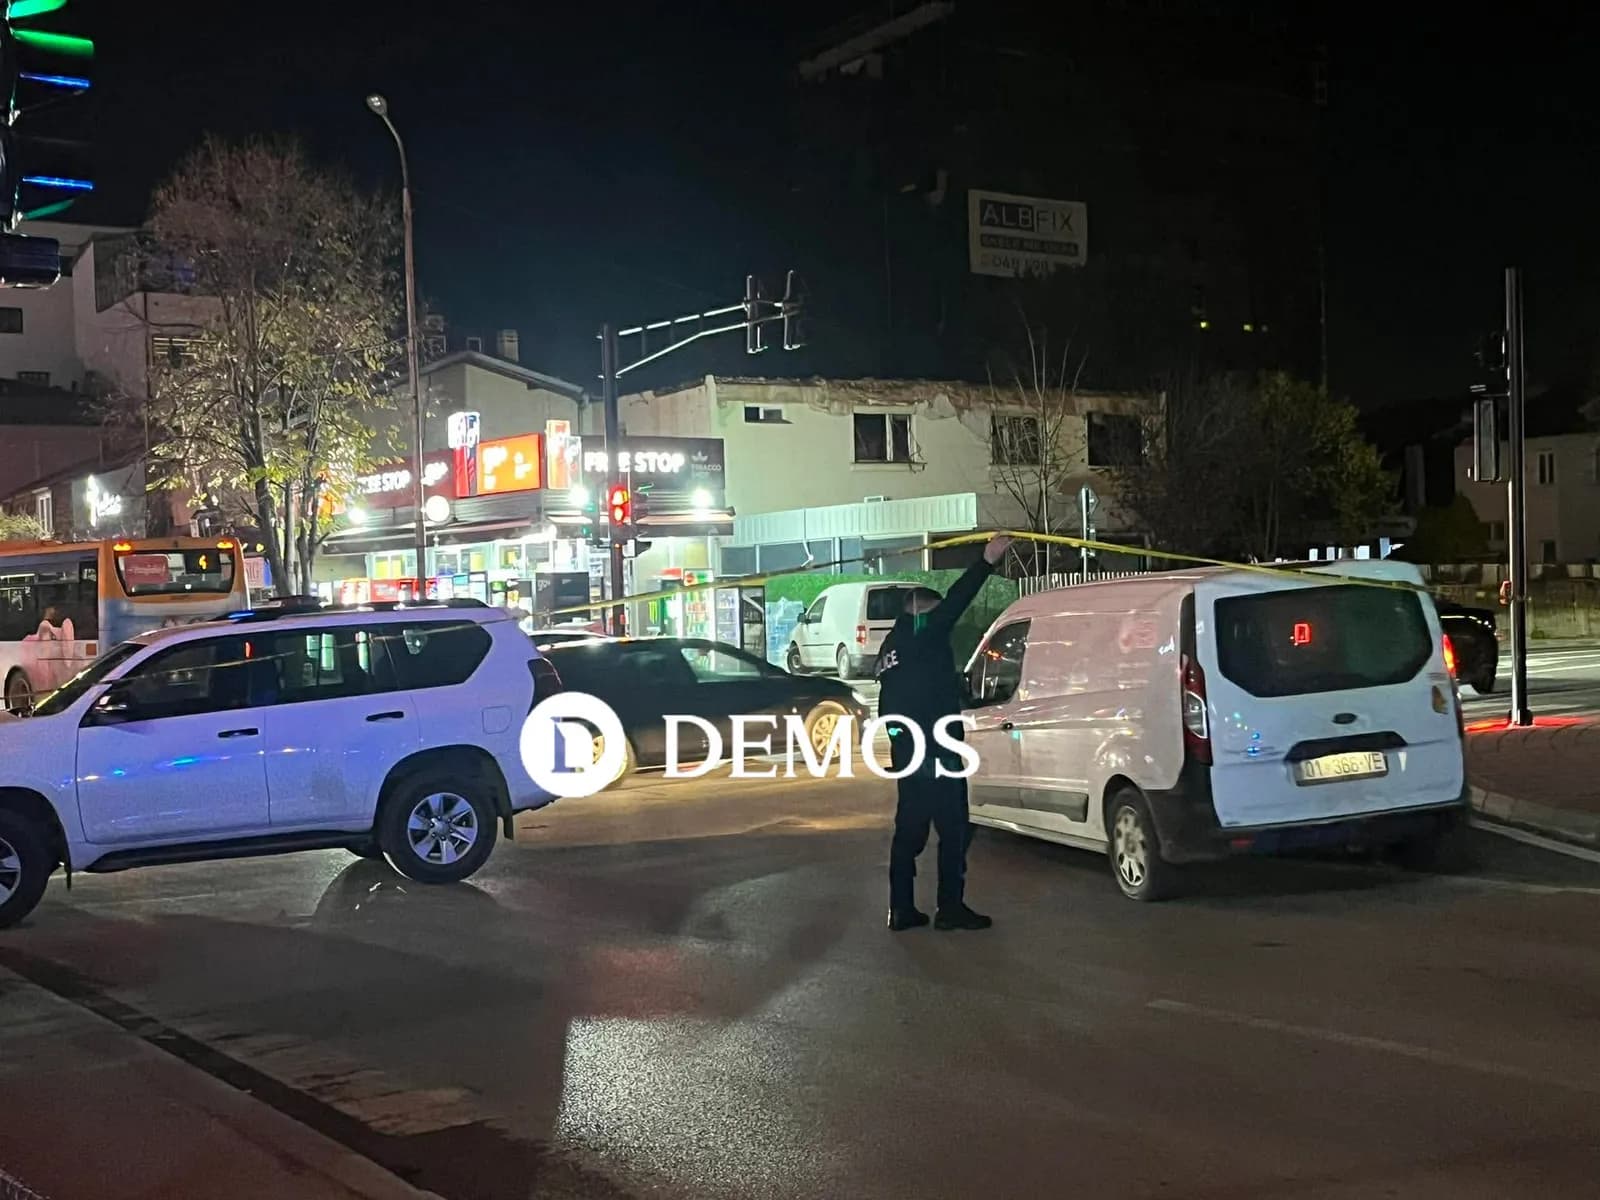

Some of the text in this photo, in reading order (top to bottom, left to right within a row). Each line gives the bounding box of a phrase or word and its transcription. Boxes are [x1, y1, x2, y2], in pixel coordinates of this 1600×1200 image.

[982, 203, 1073, 233] ALBFIX
[584, 450, 686, 474] FRE STOP
[382, 469, 411, 493] STOP
